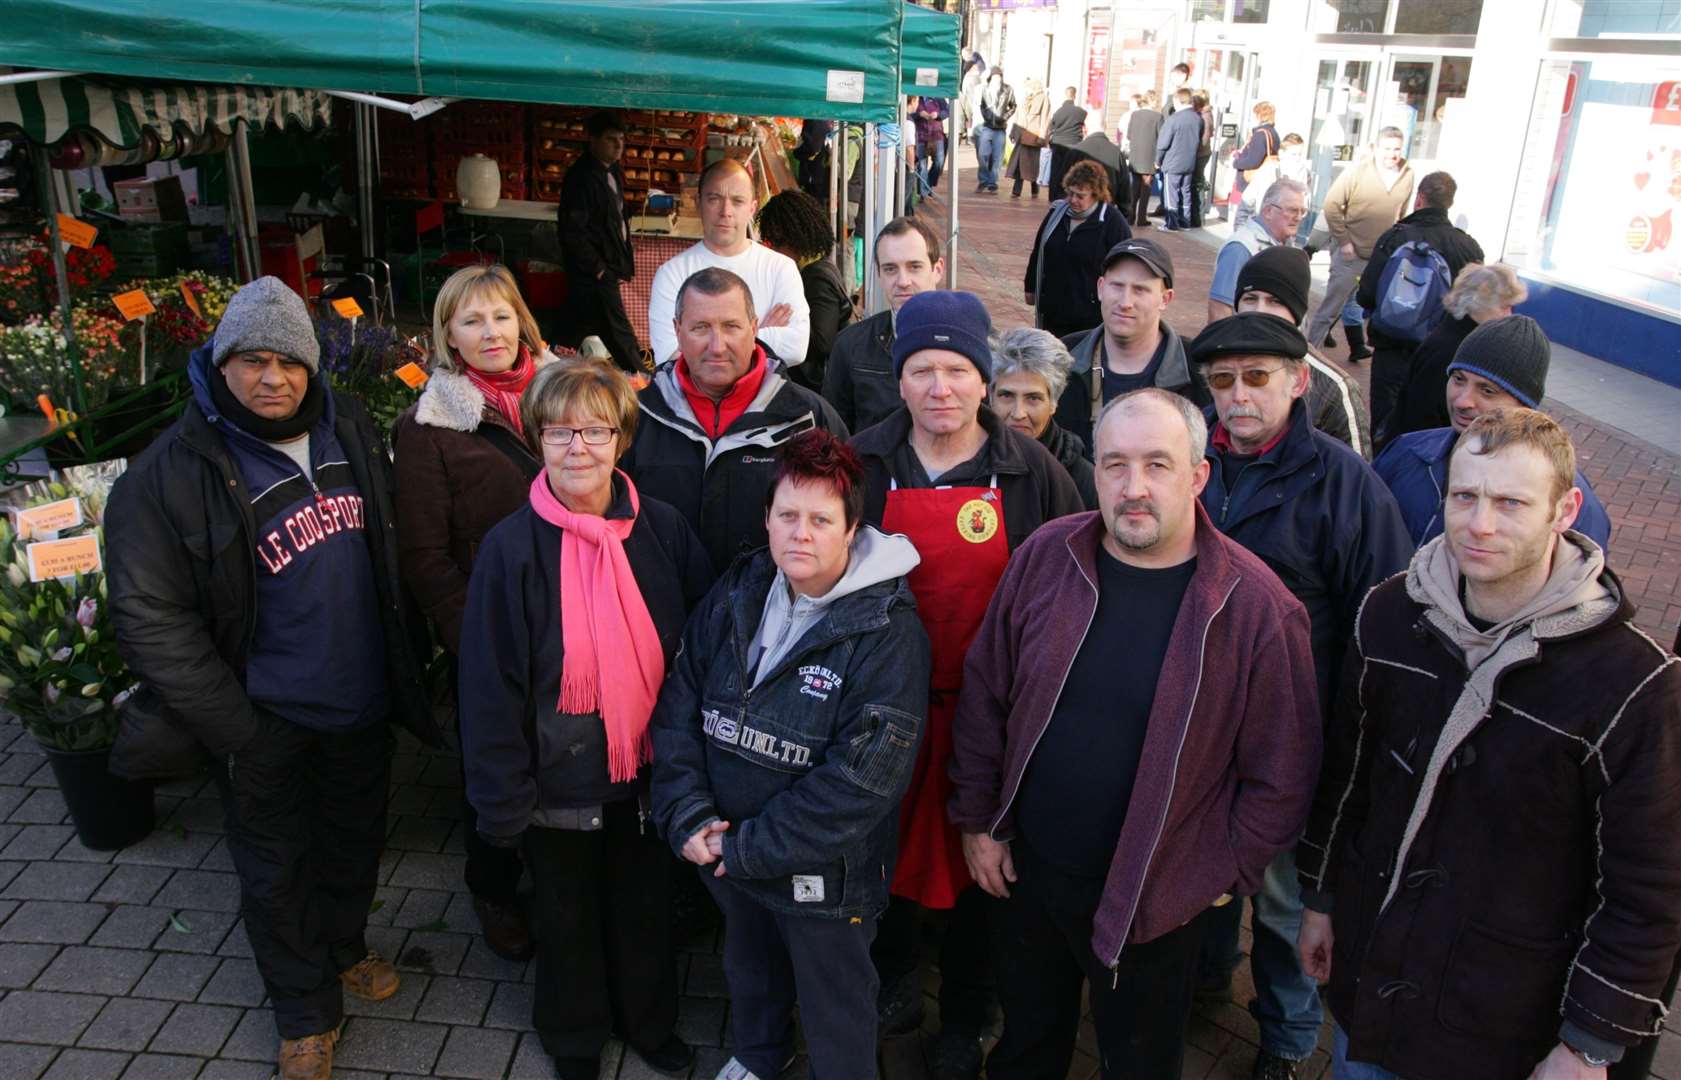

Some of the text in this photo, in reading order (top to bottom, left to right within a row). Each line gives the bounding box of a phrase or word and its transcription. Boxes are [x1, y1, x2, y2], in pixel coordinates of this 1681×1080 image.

[257, 496, 365, 575] LE COQ SPORT
[804, 674, 833, 691] 19 72
[740, 725, 814, 767] UNLTD.
